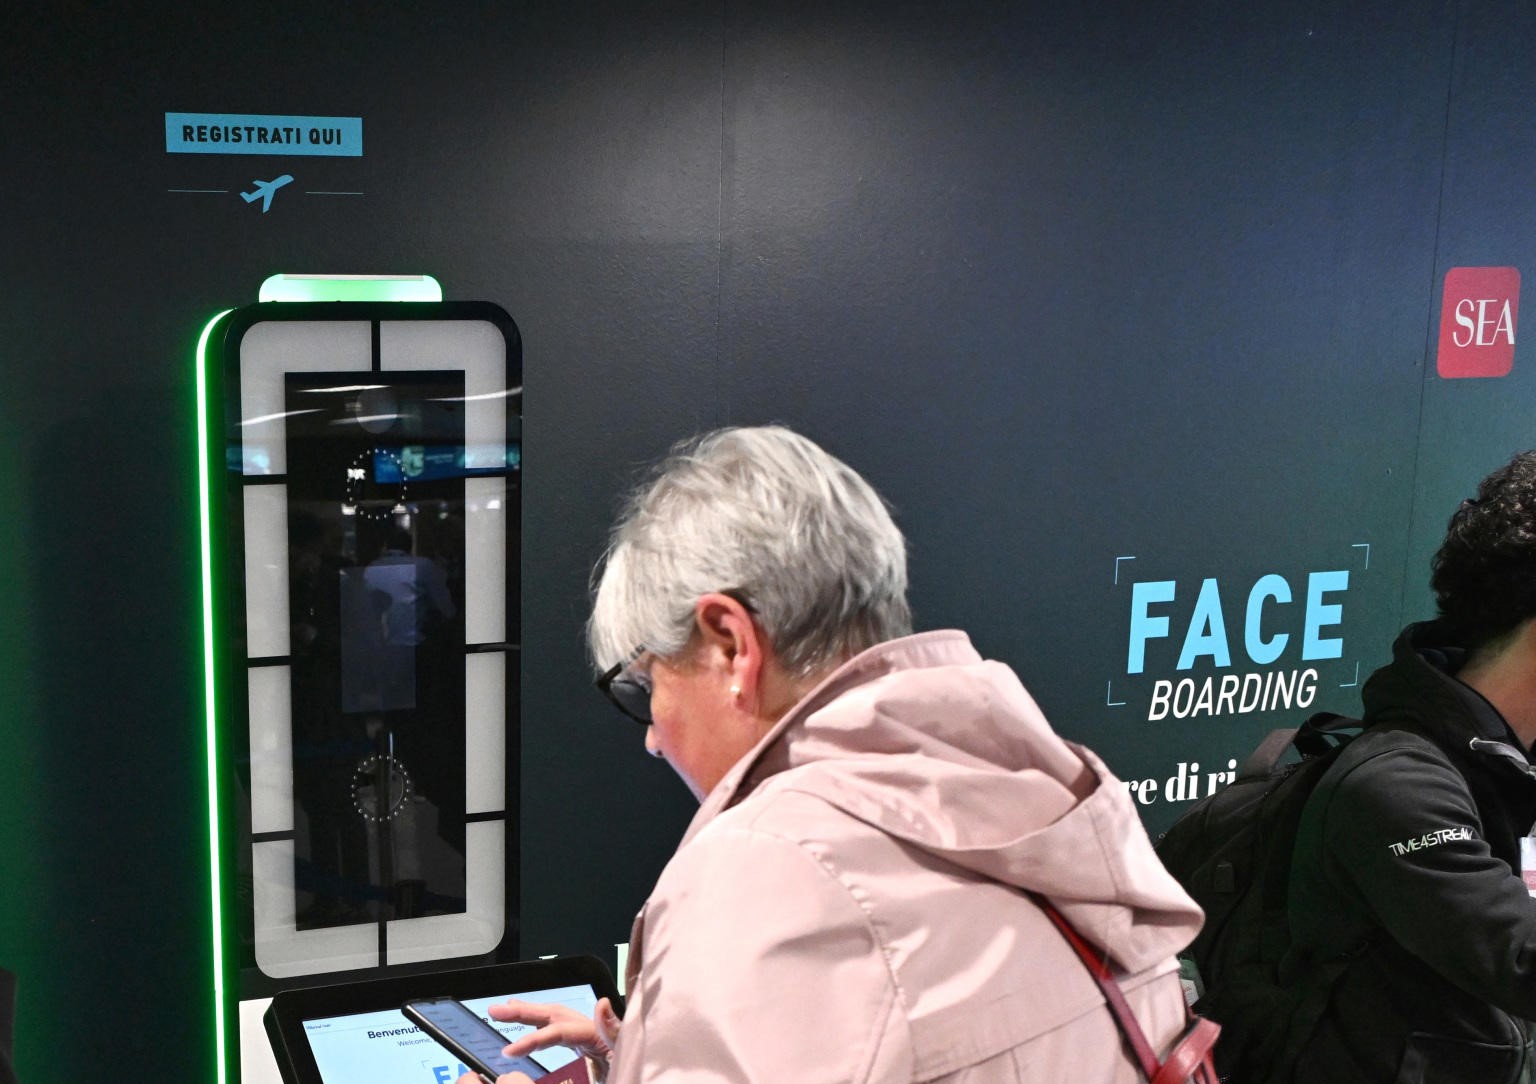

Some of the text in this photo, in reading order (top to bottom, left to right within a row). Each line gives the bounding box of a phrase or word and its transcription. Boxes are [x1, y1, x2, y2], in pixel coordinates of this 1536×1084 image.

[182, 125, 341, 145] REGISTRATI QUI
[1453, 299, 1515, 347] SEA
[1127, 570, 1349, 674] FACE
[1148, 668, 1318, 721] BOARDING
[1166, 763, 1199, 802] di
